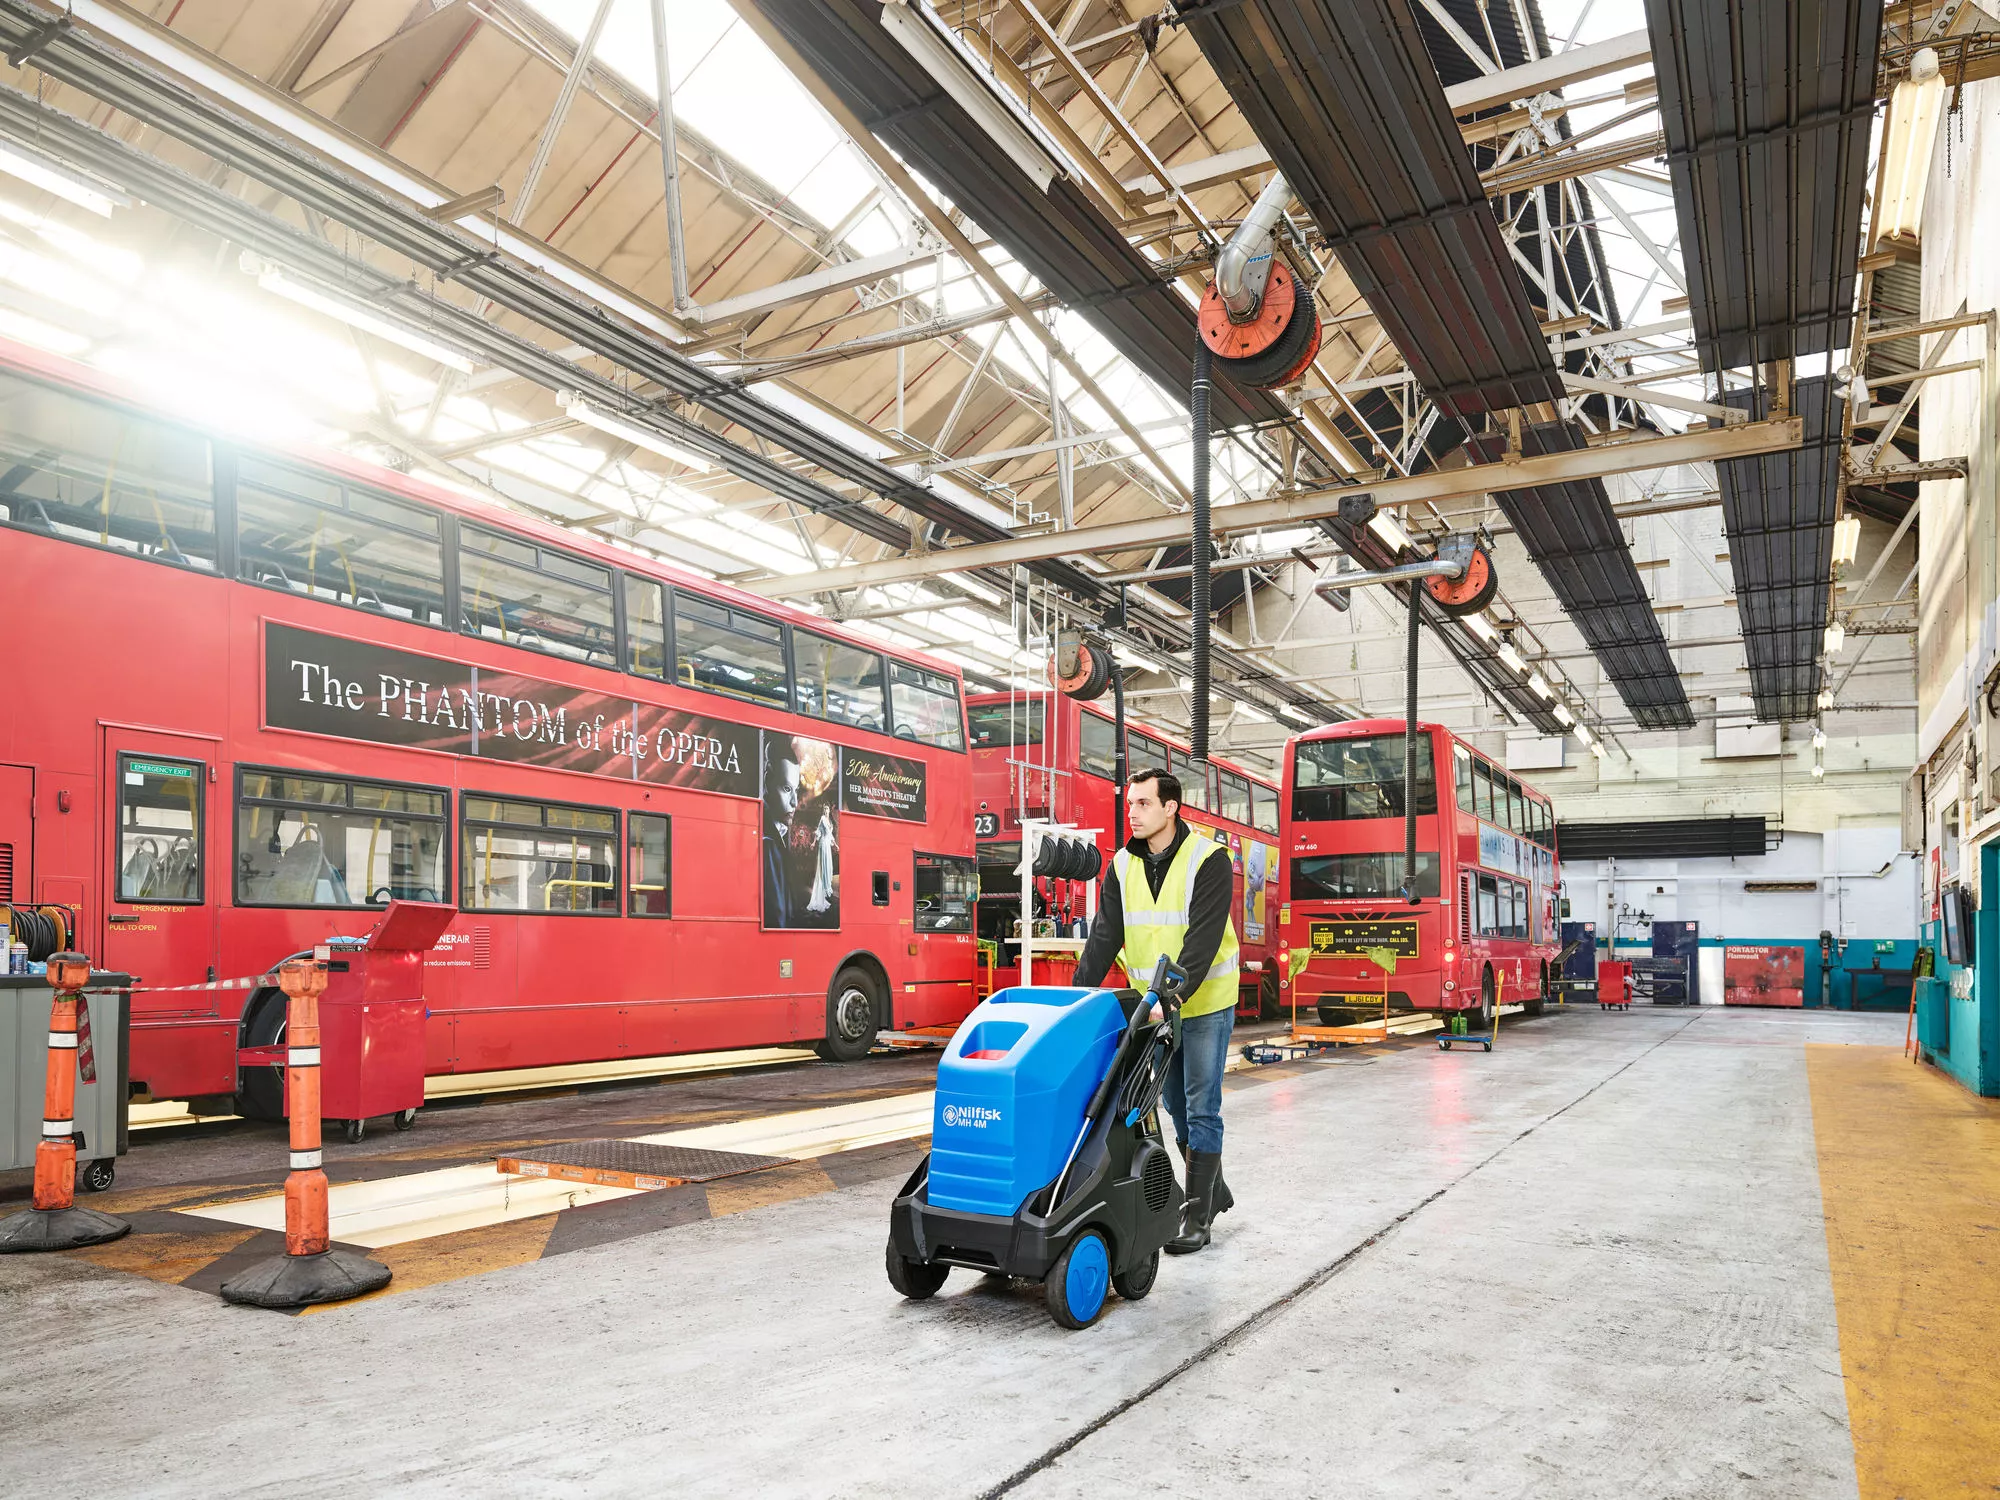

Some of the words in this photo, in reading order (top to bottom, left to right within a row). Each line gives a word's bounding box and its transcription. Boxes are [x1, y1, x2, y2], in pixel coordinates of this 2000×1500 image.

[291, 660, 365, 711] The
[377, 673, 567, 746] PHANTOM
[576, 714, 605, 751] of
[612, 720, 648, 760] the
[657, 727, 742, 774] OPERA
[134, 764, 172, 774] EMERGENCY
[845, 758, 870, 777] 30th
[870, 764, 922, 794] Anniversary
[849, 784, 862, 793] HER
[862, 786, 892, 799] MAJESTY'S
[892, 791, 917, 802] THEATRE
[1727, 946, 1769, 954] PORTASTOR
[958, 1106, 1002, 1120] Nilfisk
[958, 1118, 972, 1127] MH
[973, 1120, 987, 1128] 4M
